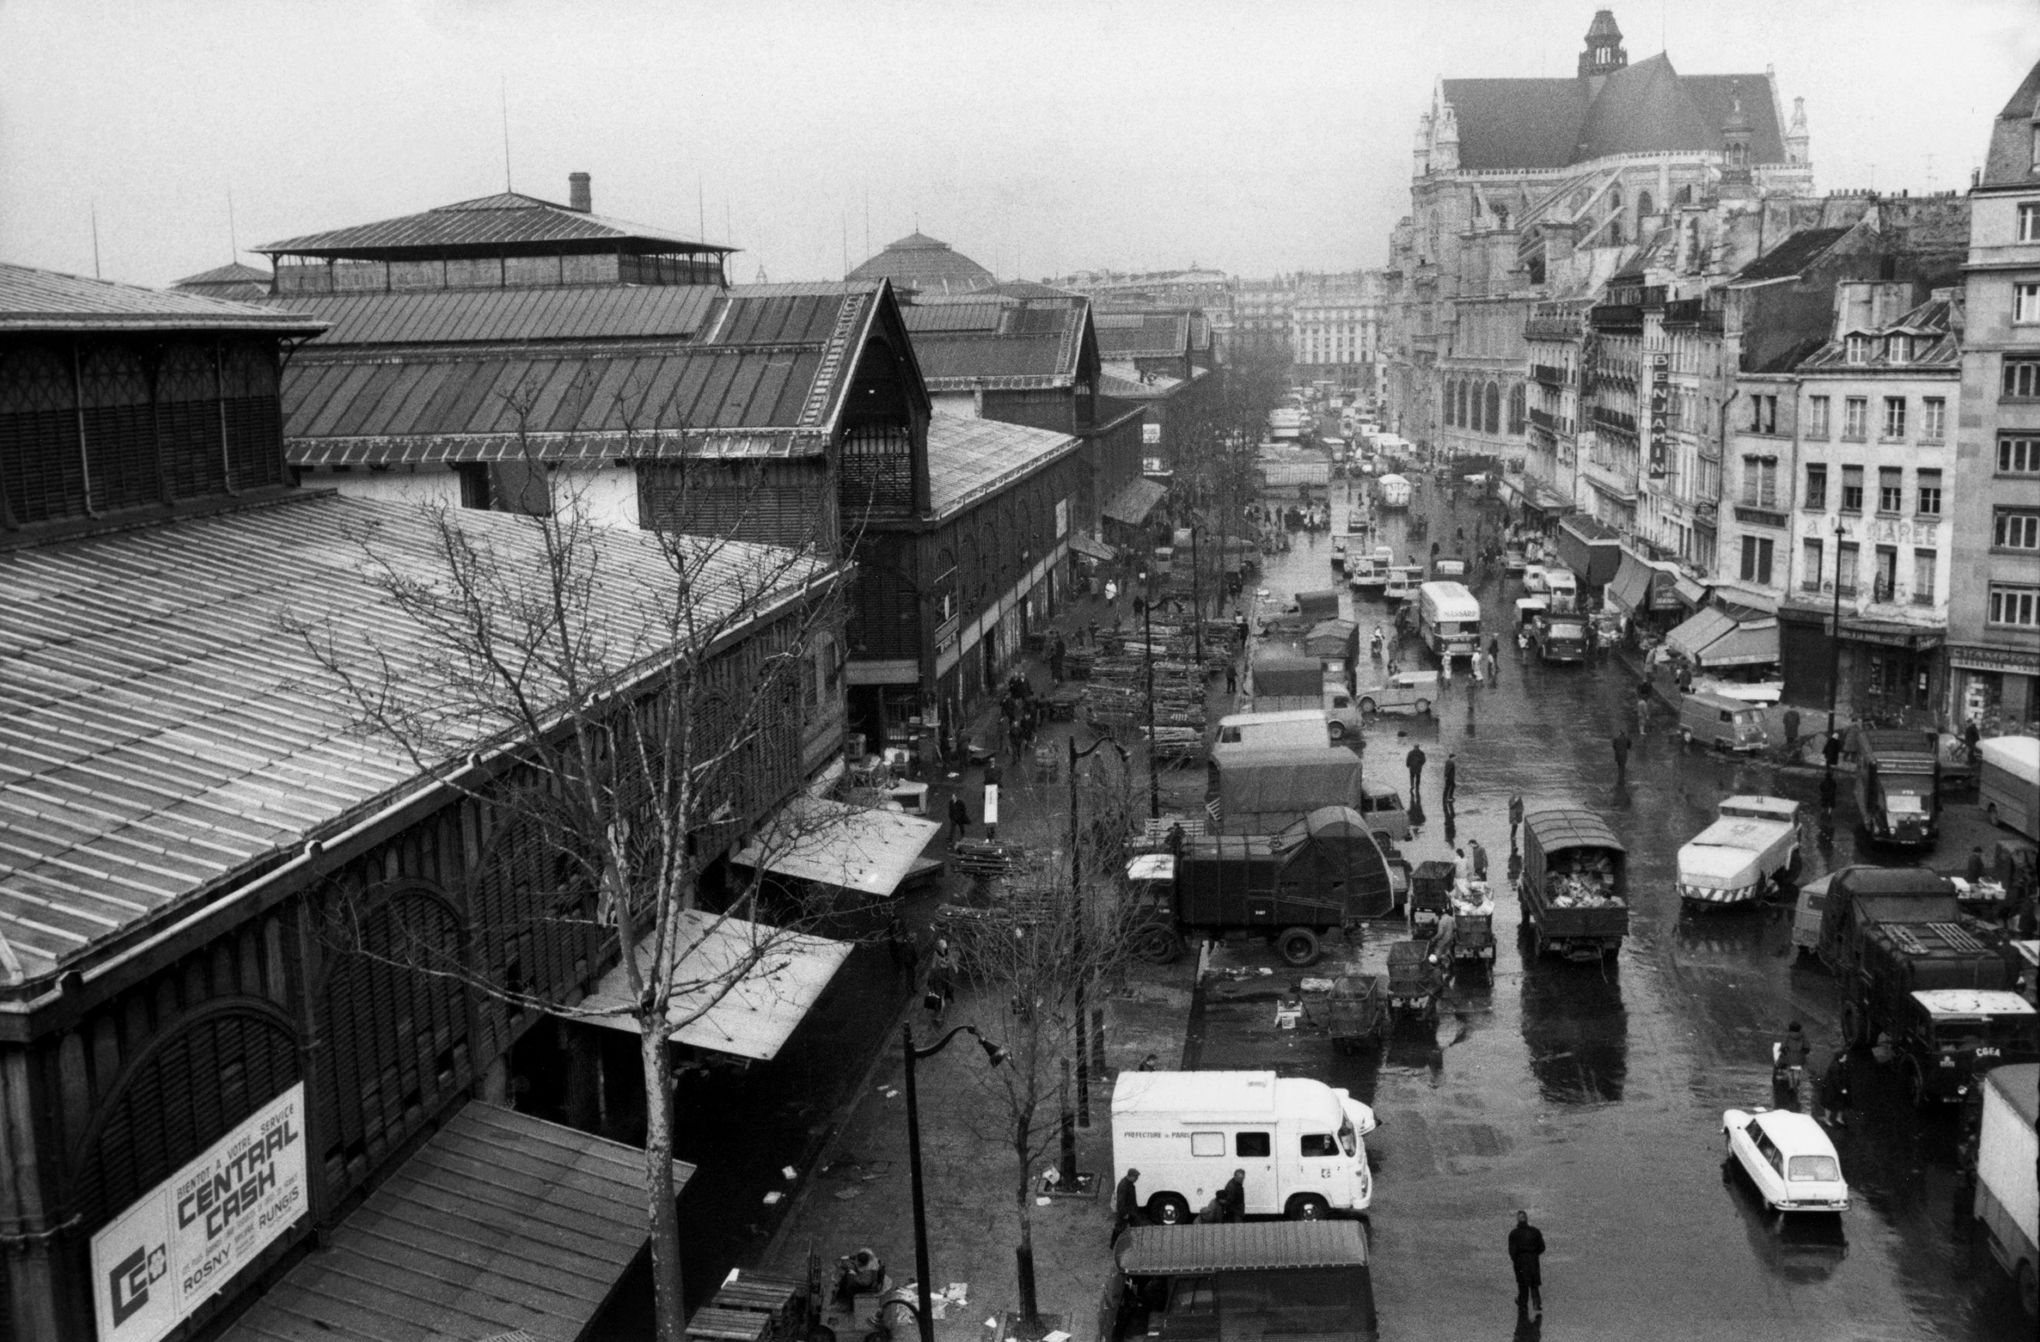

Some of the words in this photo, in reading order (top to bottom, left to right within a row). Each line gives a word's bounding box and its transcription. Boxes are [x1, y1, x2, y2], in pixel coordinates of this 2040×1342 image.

[1651, 354, 1668, 474] BENJAMIN
[1975, 1046, 2001, 1057] CGEA
[176, 1166, 210, 1201] BIENTOT
[260, 1102, 295, 1136] SERVICE
[178, 1119, 299, 1231] CENTRAL
[206, 1160, 275, 1241] CASH
[258, 1185, 300, 1229] RUNGIS
[183, 1242, 231, 1294] ROSNY
